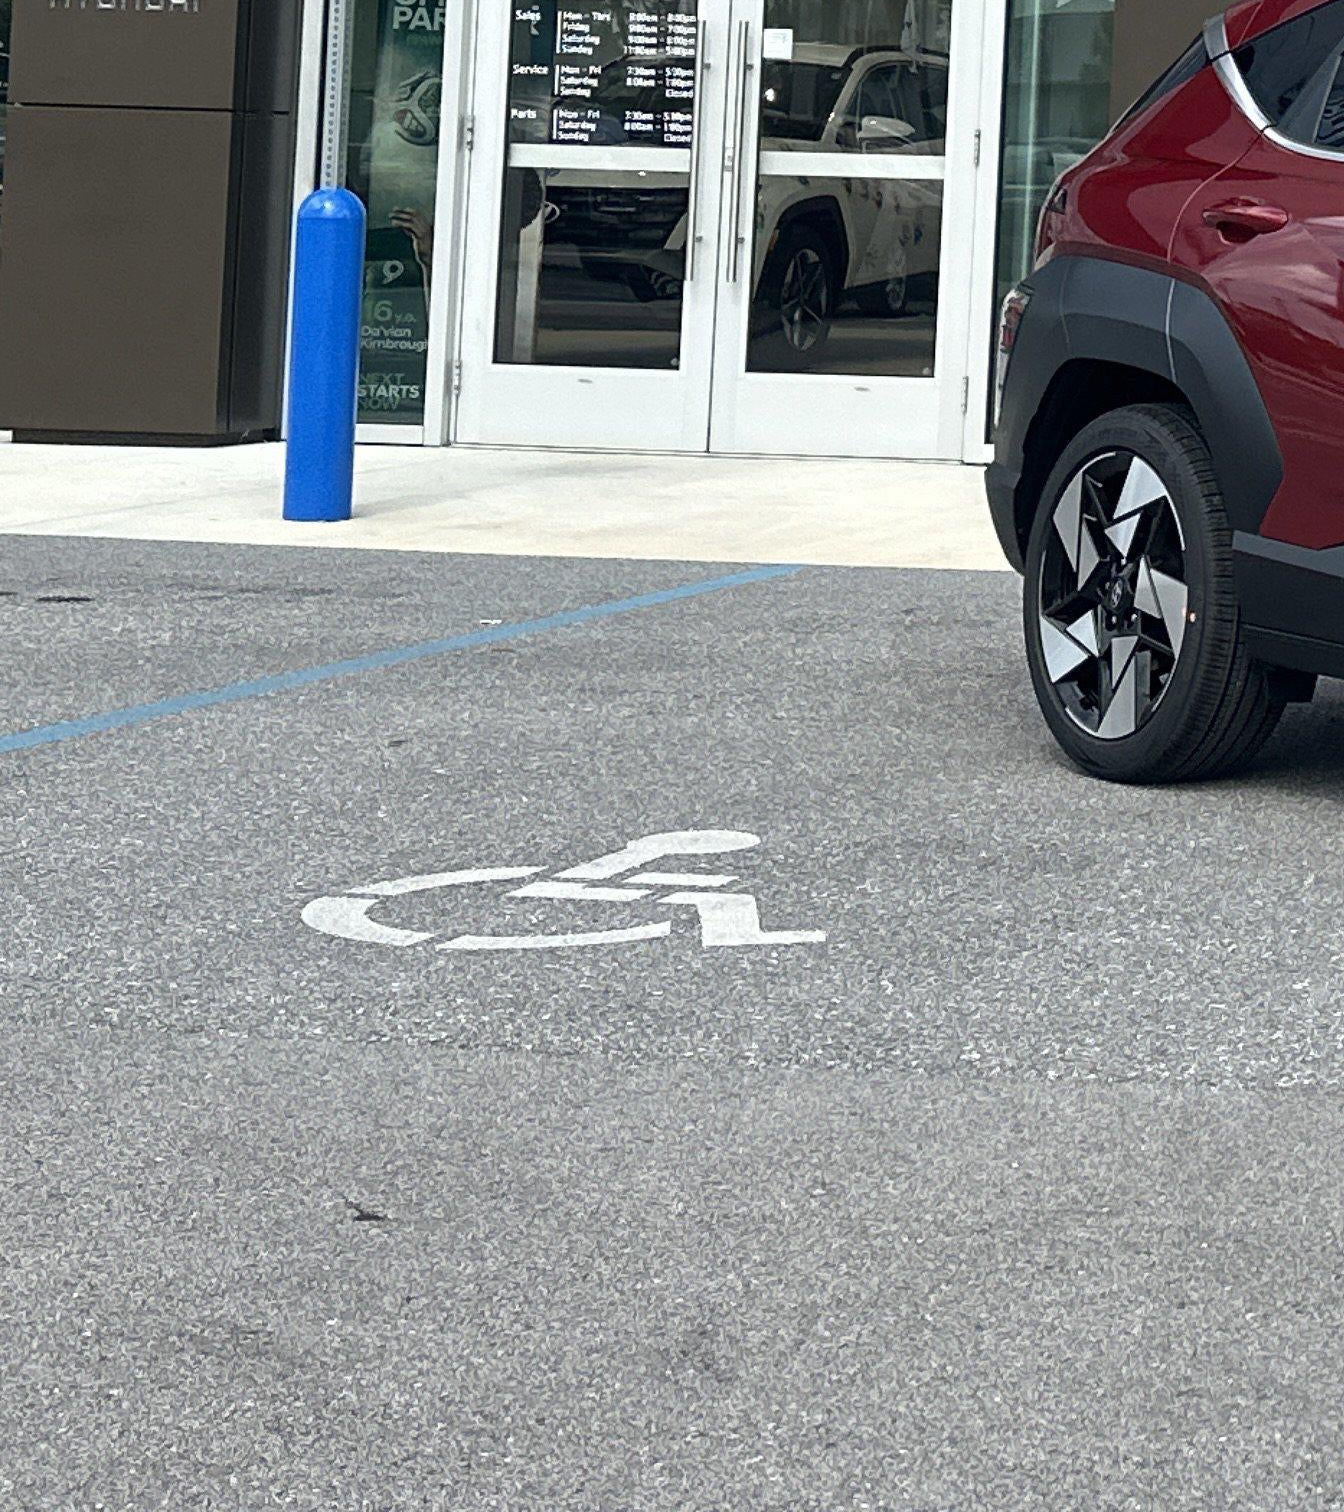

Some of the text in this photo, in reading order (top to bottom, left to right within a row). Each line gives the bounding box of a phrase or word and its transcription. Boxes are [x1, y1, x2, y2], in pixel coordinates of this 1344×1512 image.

[515, 9, 541, 21] Sales
[562, 34, 600, 45] Saturday
[562, 45, 593, 55] Sunday
[512, 64, 548, 75] Service
[560, 76, 598, 87] Saturday
[511, 108, 537, 119] Parts
[559, 121, 596, 132] Saturday
[357, 384, 420, 399] STARTS
